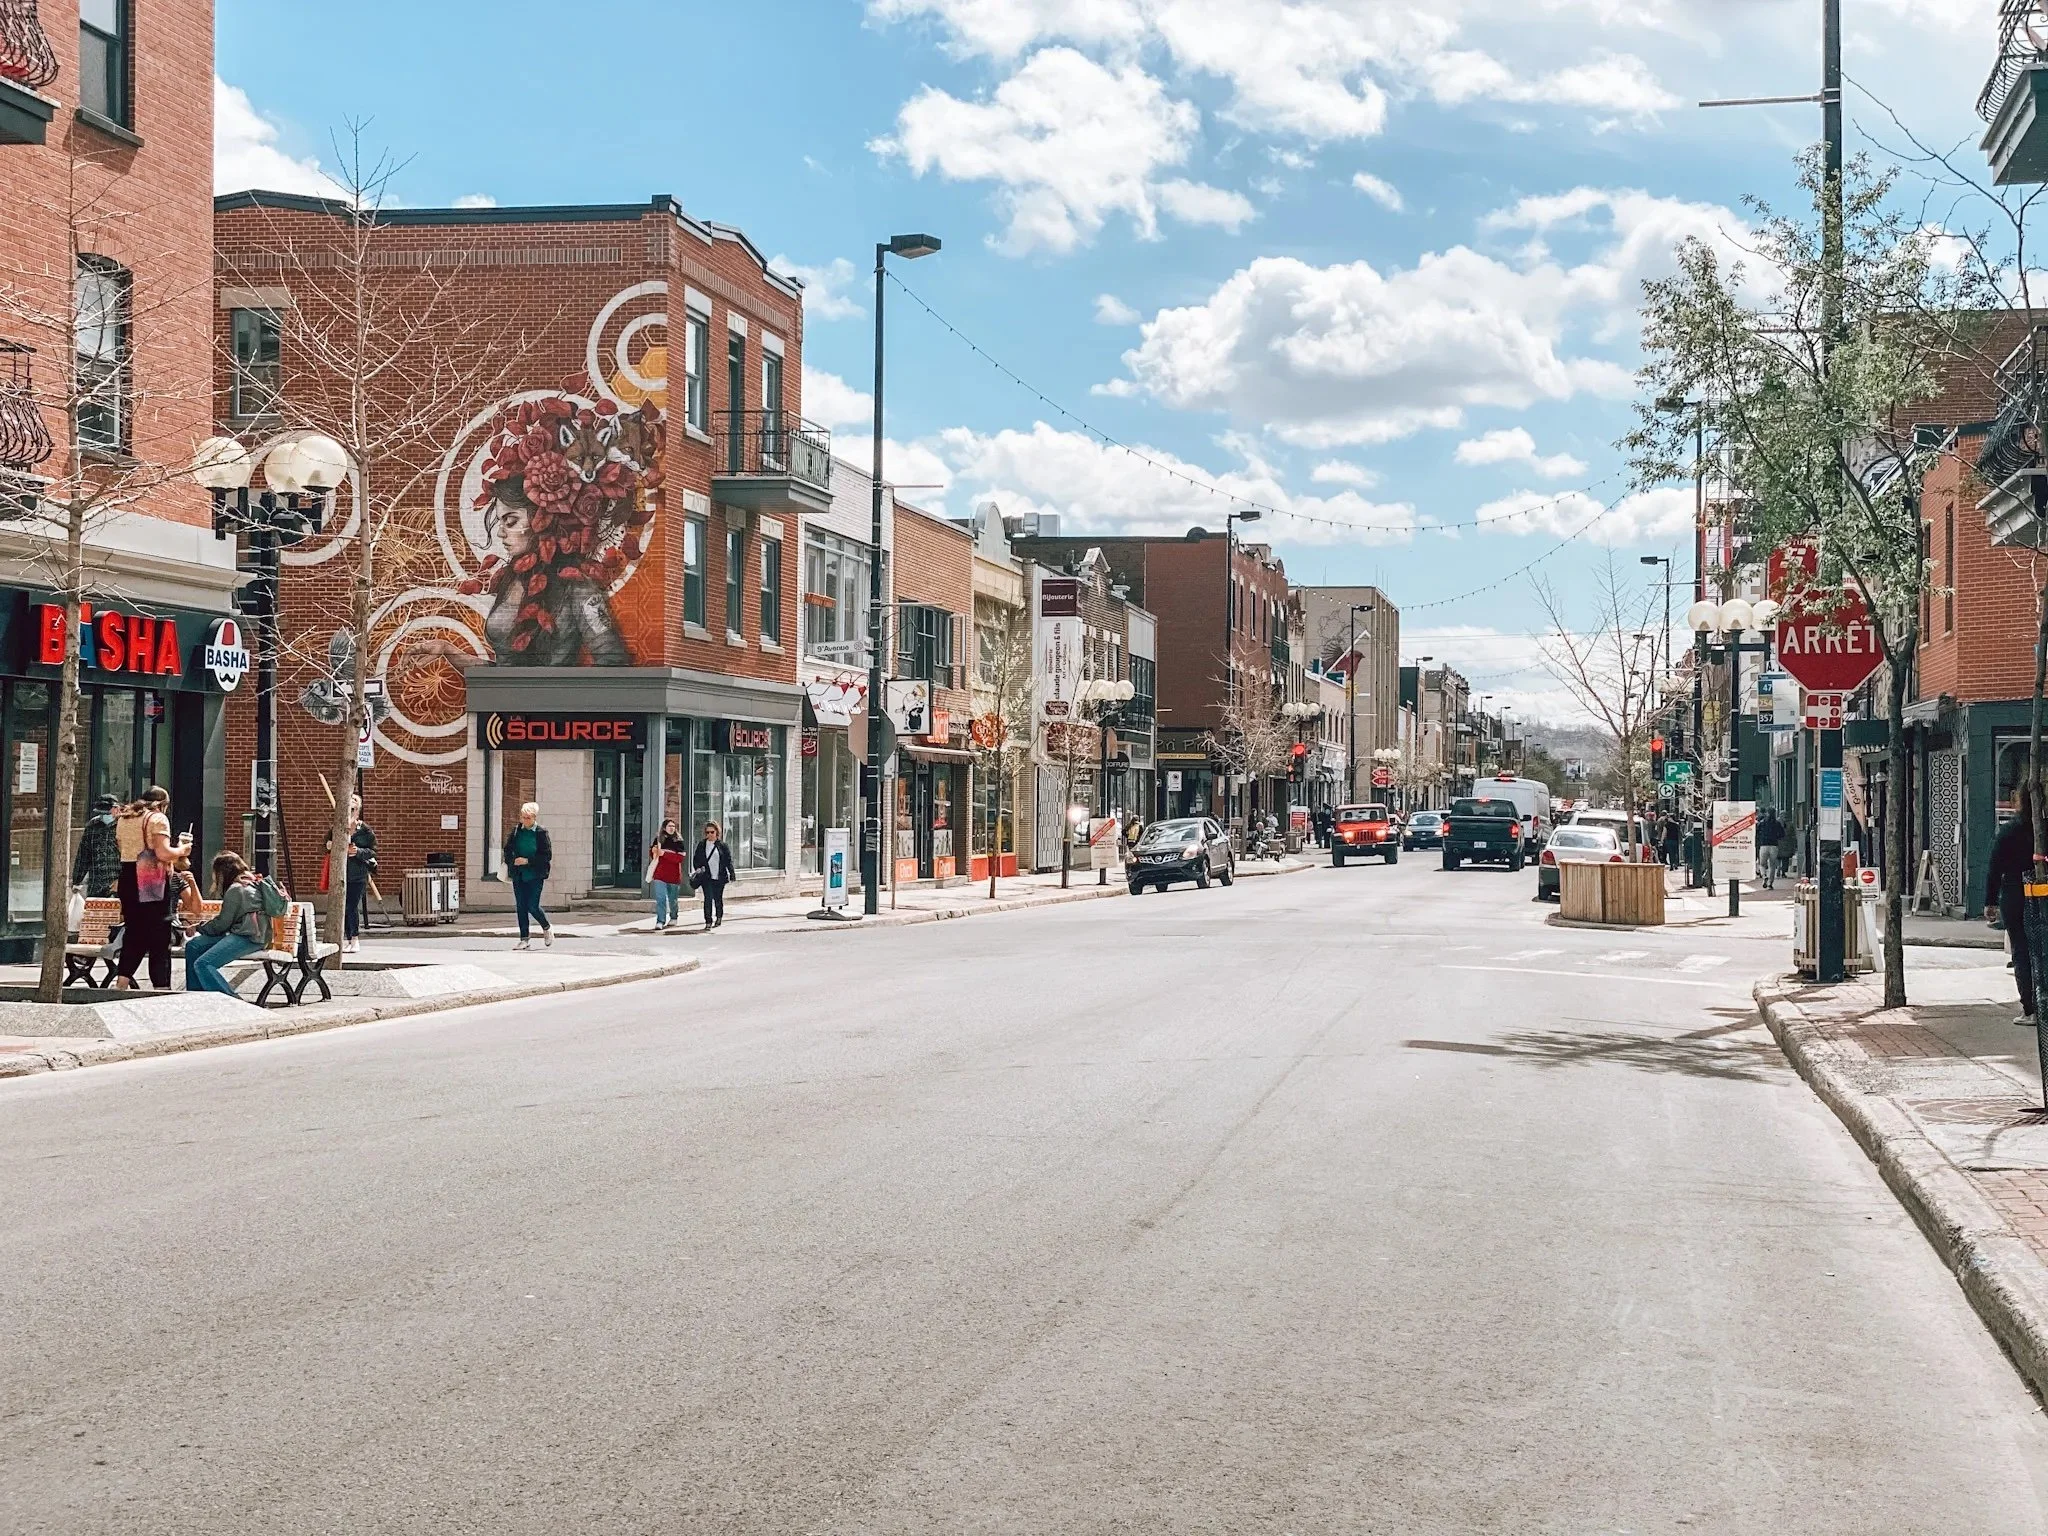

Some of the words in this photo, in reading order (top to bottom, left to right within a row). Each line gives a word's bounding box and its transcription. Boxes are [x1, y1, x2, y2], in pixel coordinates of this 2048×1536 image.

[1042, 593, 1074, 601] Bijouterie
[1782, 620, 1876, 655] ARRÊT
[206, 648, 247, 669] BASHA
[1762, 684, 1773, 692] 47
[1759, 714, 1773, 722] 357
[507, 721, 632, 740] SOURCE
[735, 729, 769, 748] SOURCE
[1668, 765, 1678, 776] P
